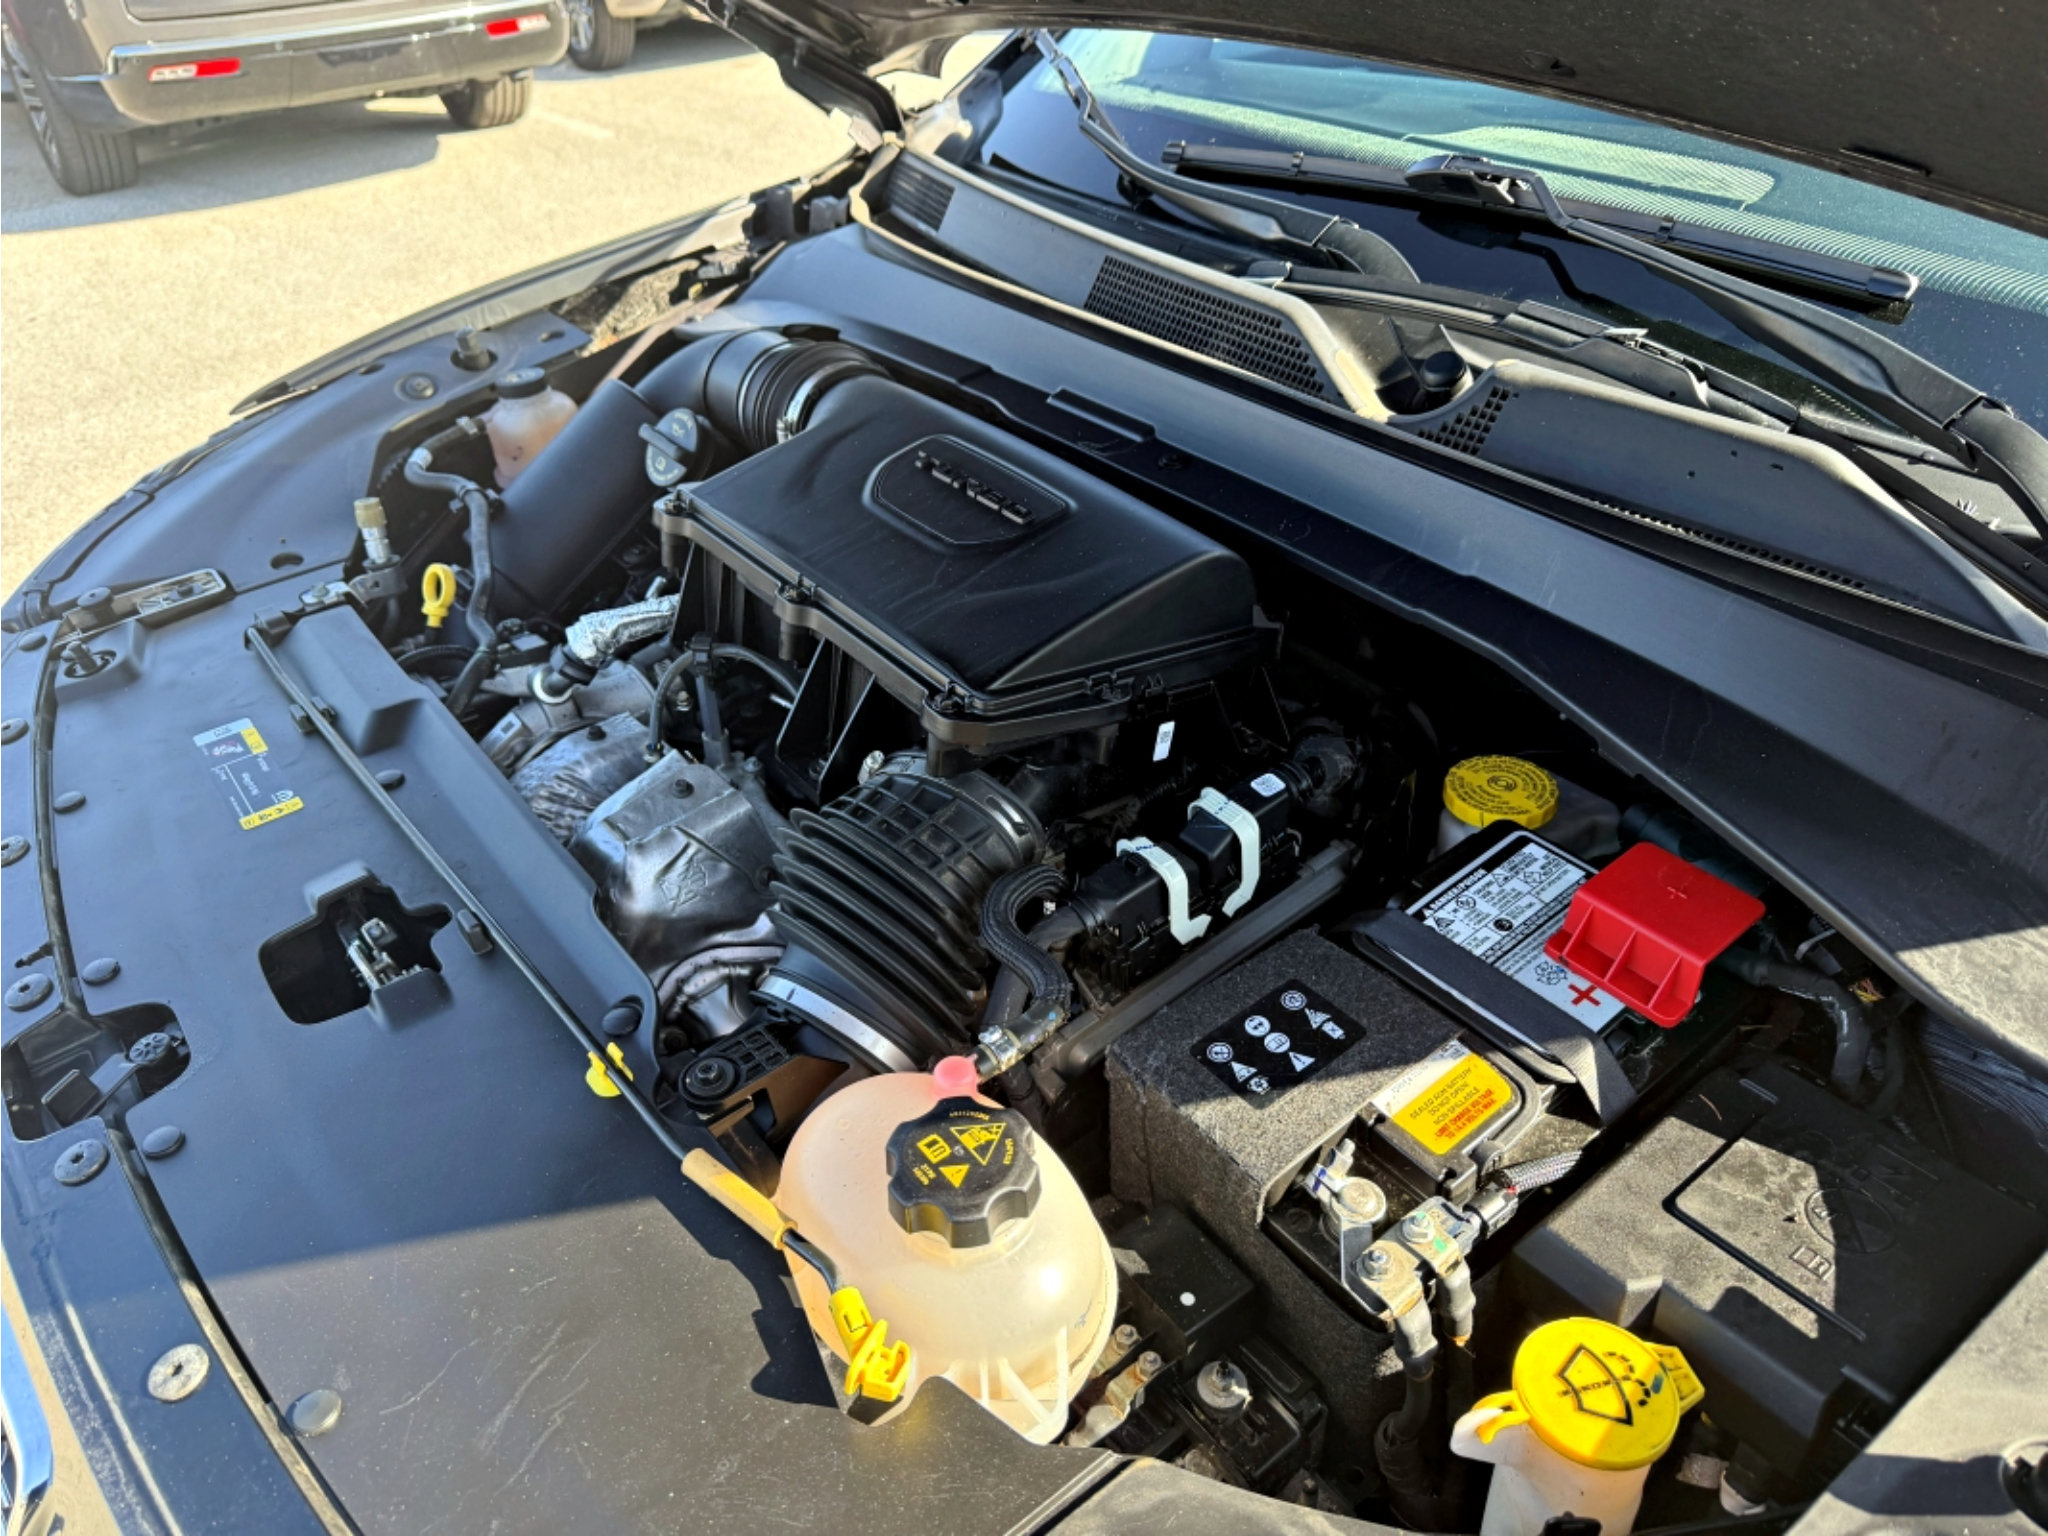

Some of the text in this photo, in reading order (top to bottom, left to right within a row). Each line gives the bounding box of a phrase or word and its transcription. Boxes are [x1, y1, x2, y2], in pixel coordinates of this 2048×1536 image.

[1410, 1097, 1434, 1119] SEALED
[1446, 1067, 1472, 1089] BATTERY
[1428, 1106, 1440, 1116] DO
[1438, 1096, 1450, 1107] NOT
